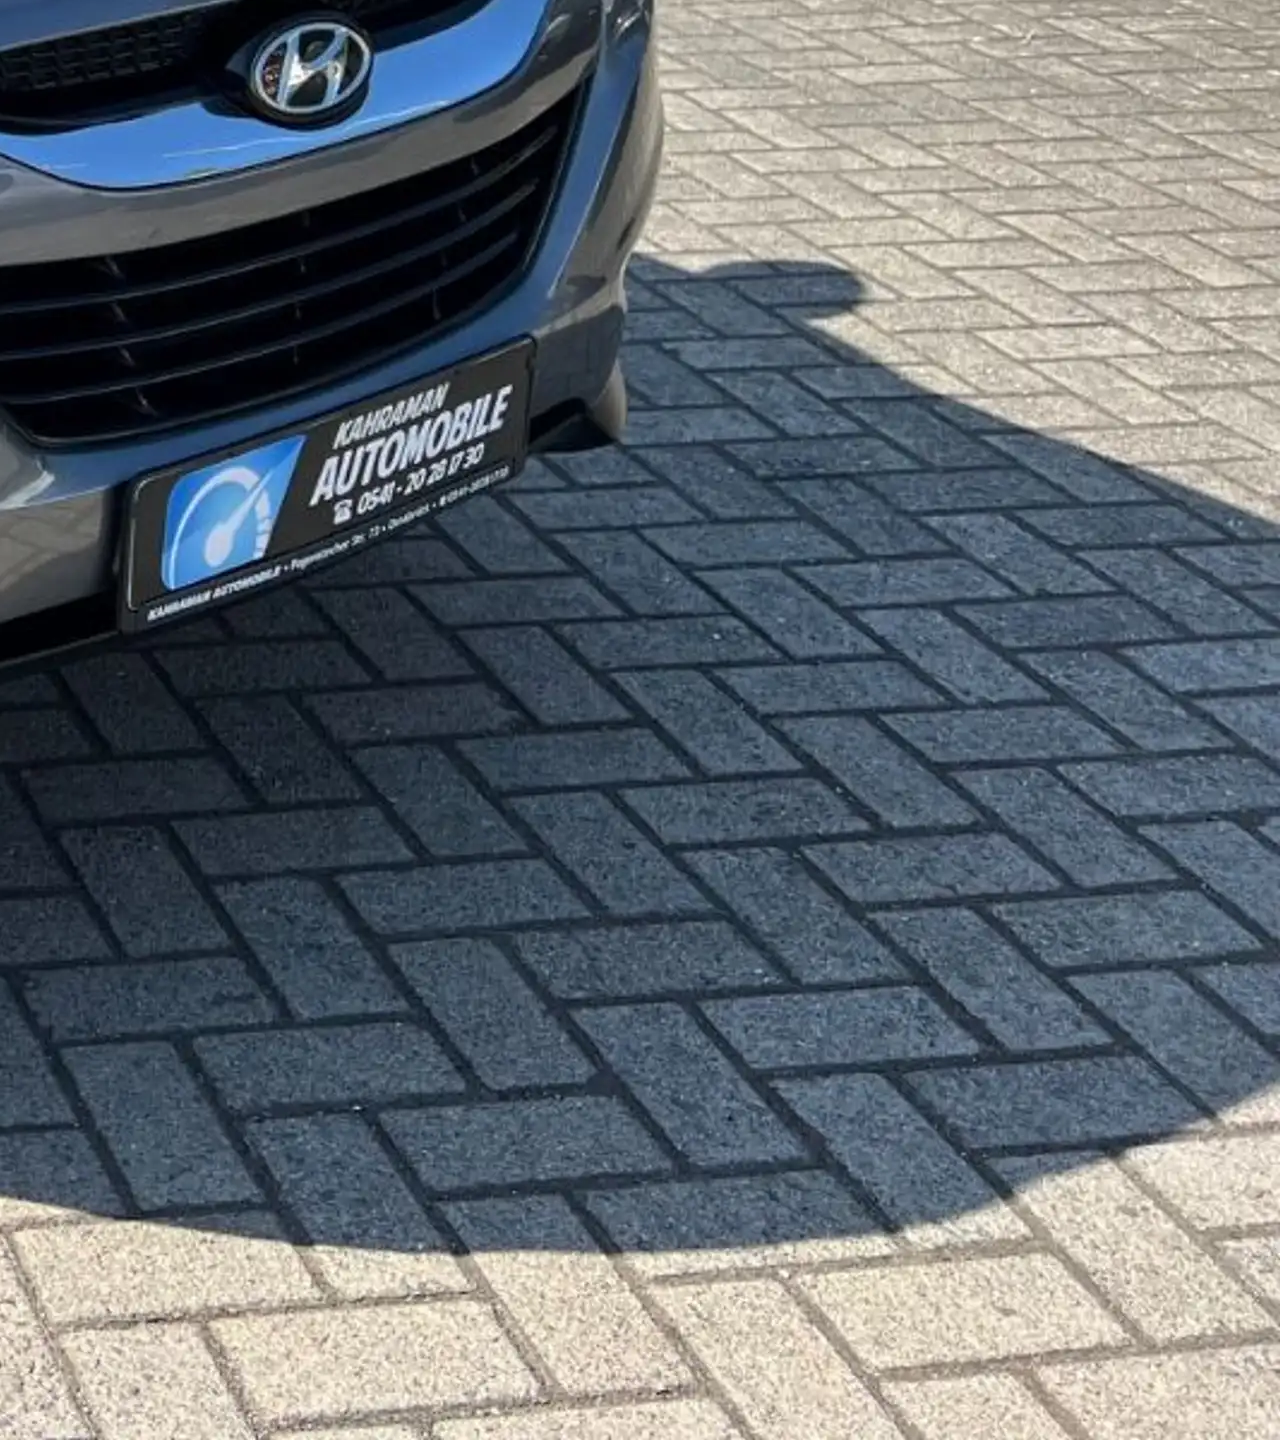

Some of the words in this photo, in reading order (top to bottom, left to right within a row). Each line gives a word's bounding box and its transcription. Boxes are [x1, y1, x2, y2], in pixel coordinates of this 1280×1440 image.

[308, 384, 514, 507] AUTOMOBILE
[333, 381, 451, 450] KAHRAMAN
[356, 480, 396, 515] 0541
[404, 467, 427, 496] 20
[426, 458, 448, 486] 28
[463, 442, 485, 469] 30
[147, 590, 214, 623] KAHRAMAN
[213, 564, 283, 599] AUTOMOBILE
